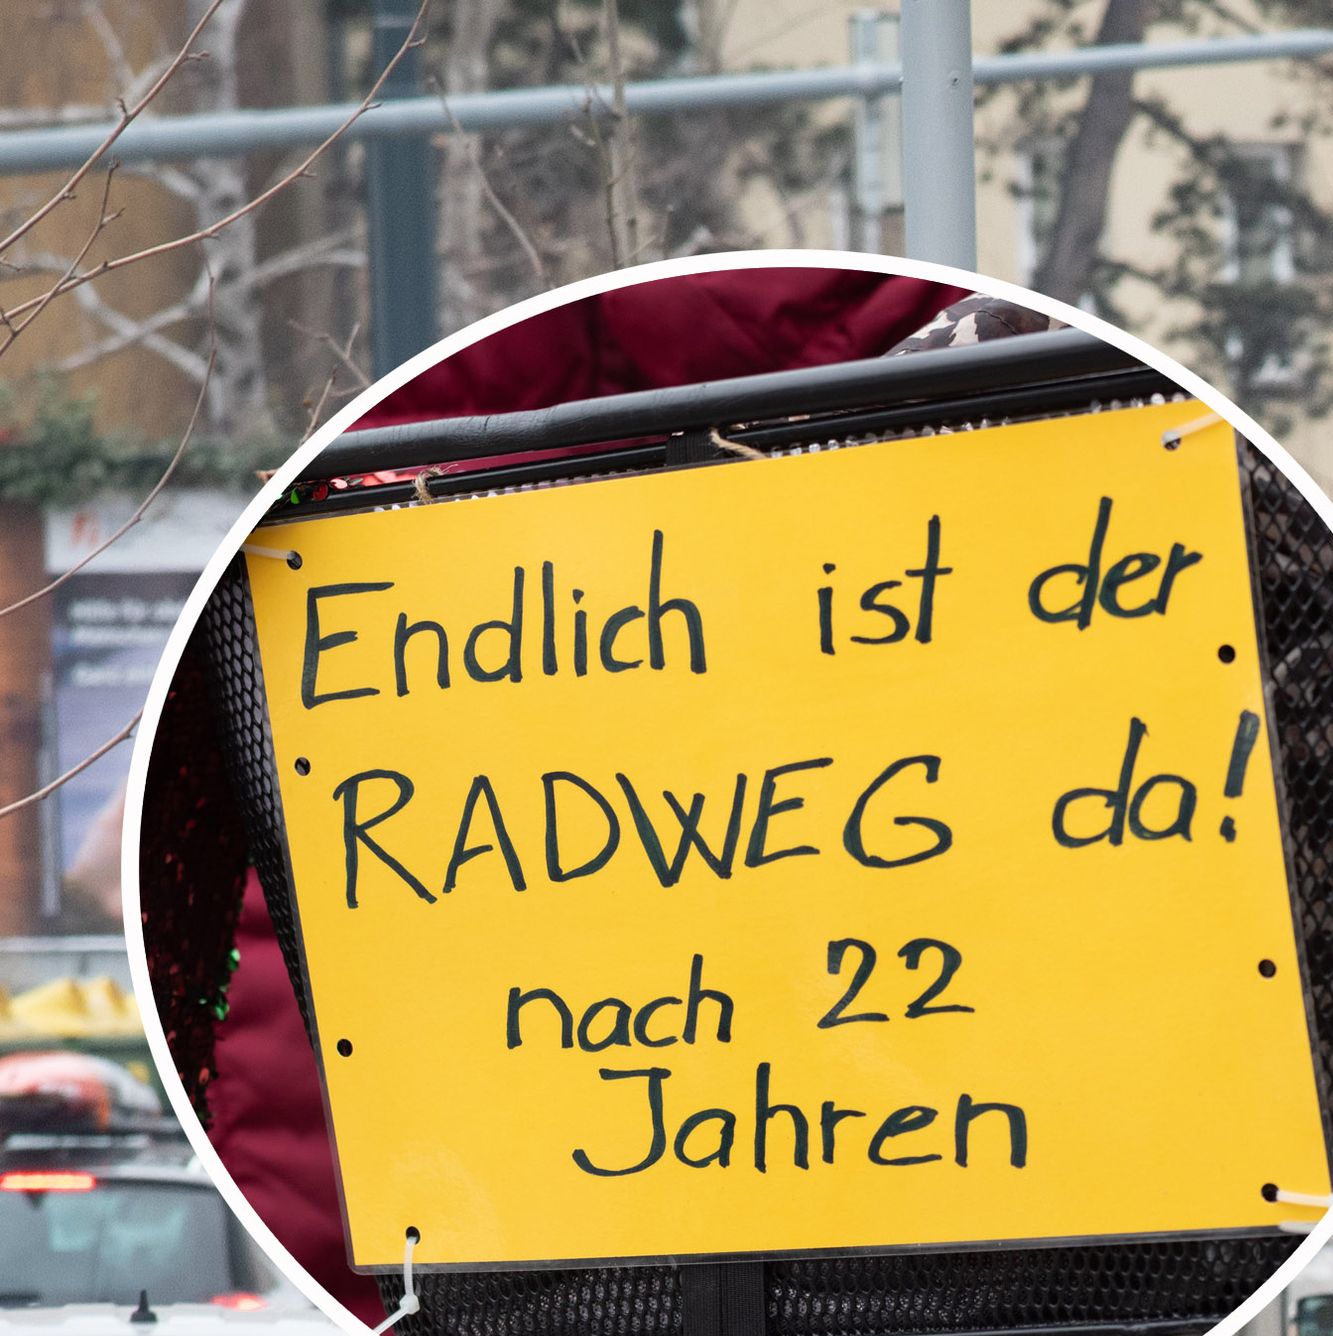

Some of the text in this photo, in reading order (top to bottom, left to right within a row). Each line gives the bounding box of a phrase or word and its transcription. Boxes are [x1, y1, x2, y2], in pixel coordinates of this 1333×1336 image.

[300, 496, 1203, 710] Endlich ist der
[332, 709, 1261, 910] RADWEG da!
[506, 937, 975, 1053] nach 22
[571, 1062, 1028, 1177] Jahren
